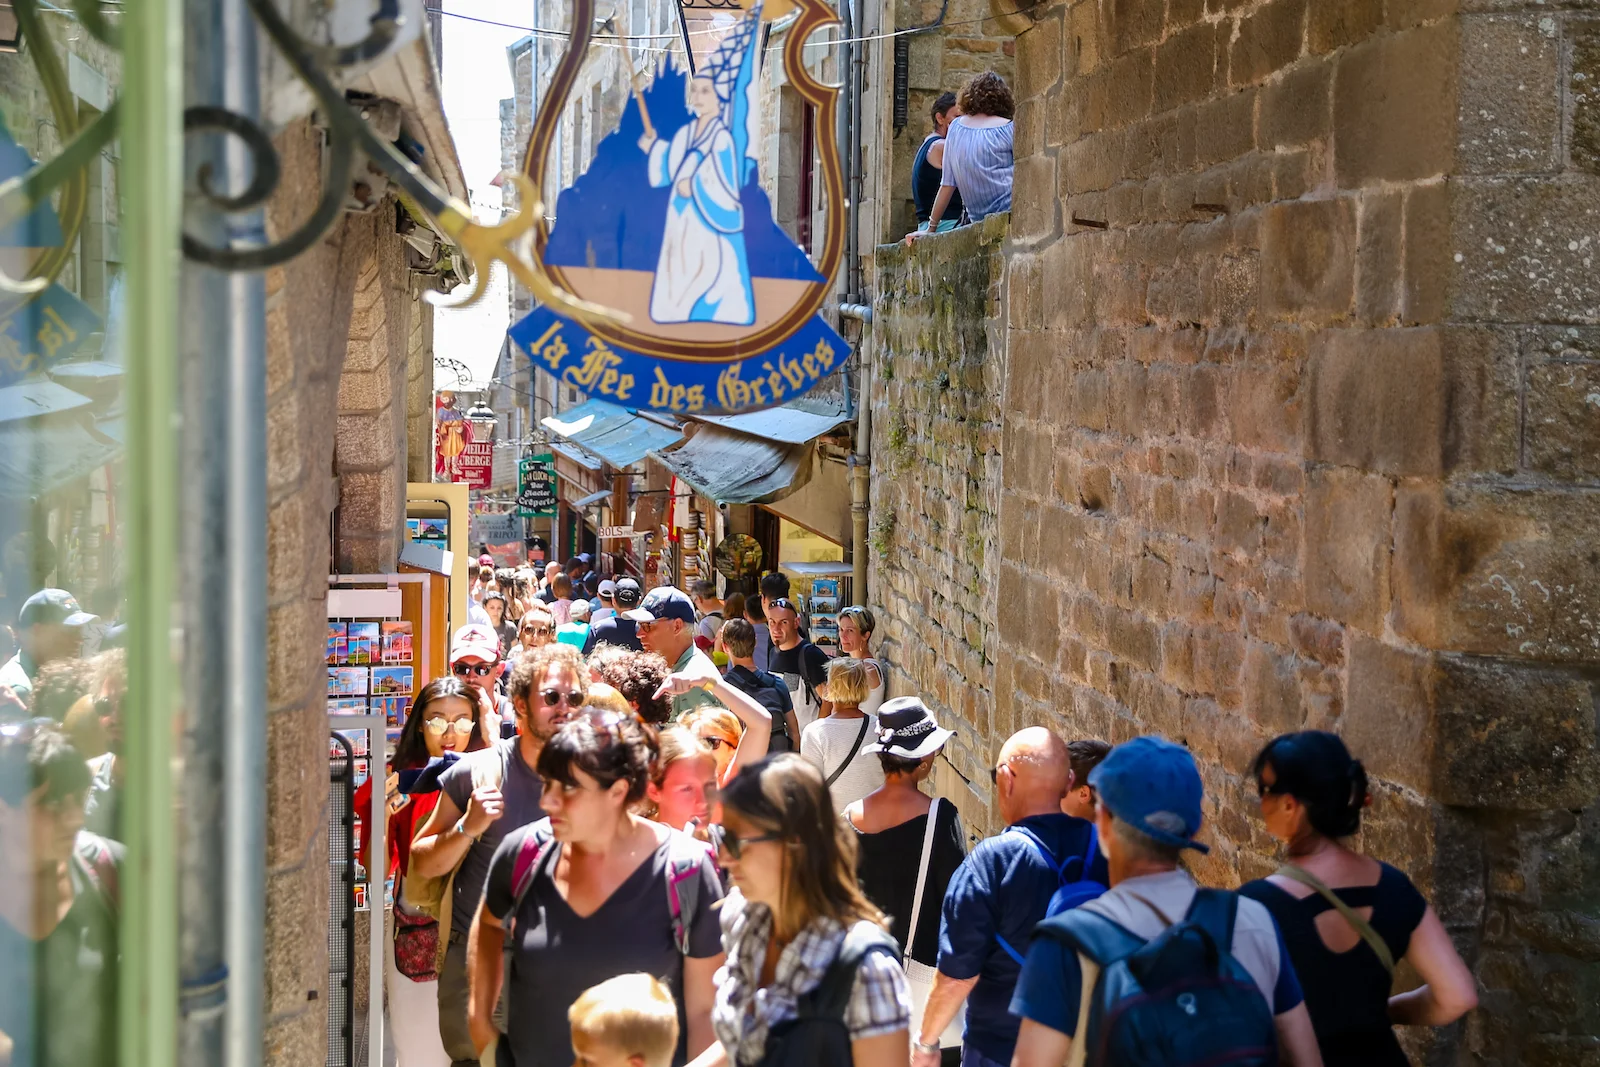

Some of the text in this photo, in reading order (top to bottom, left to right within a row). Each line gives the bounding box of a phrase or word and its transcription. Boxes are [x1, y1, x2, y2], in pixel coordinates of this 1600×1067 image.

[530, 321, 569, 369] la
[649, 366, 704, 411] des
[717, 337, 835, 412] Grèves
[458, 455, 491, 466] UBERGE
[488, 530, 517, 539] TRIPOT
[598, 526, 623, 537] BOLS
